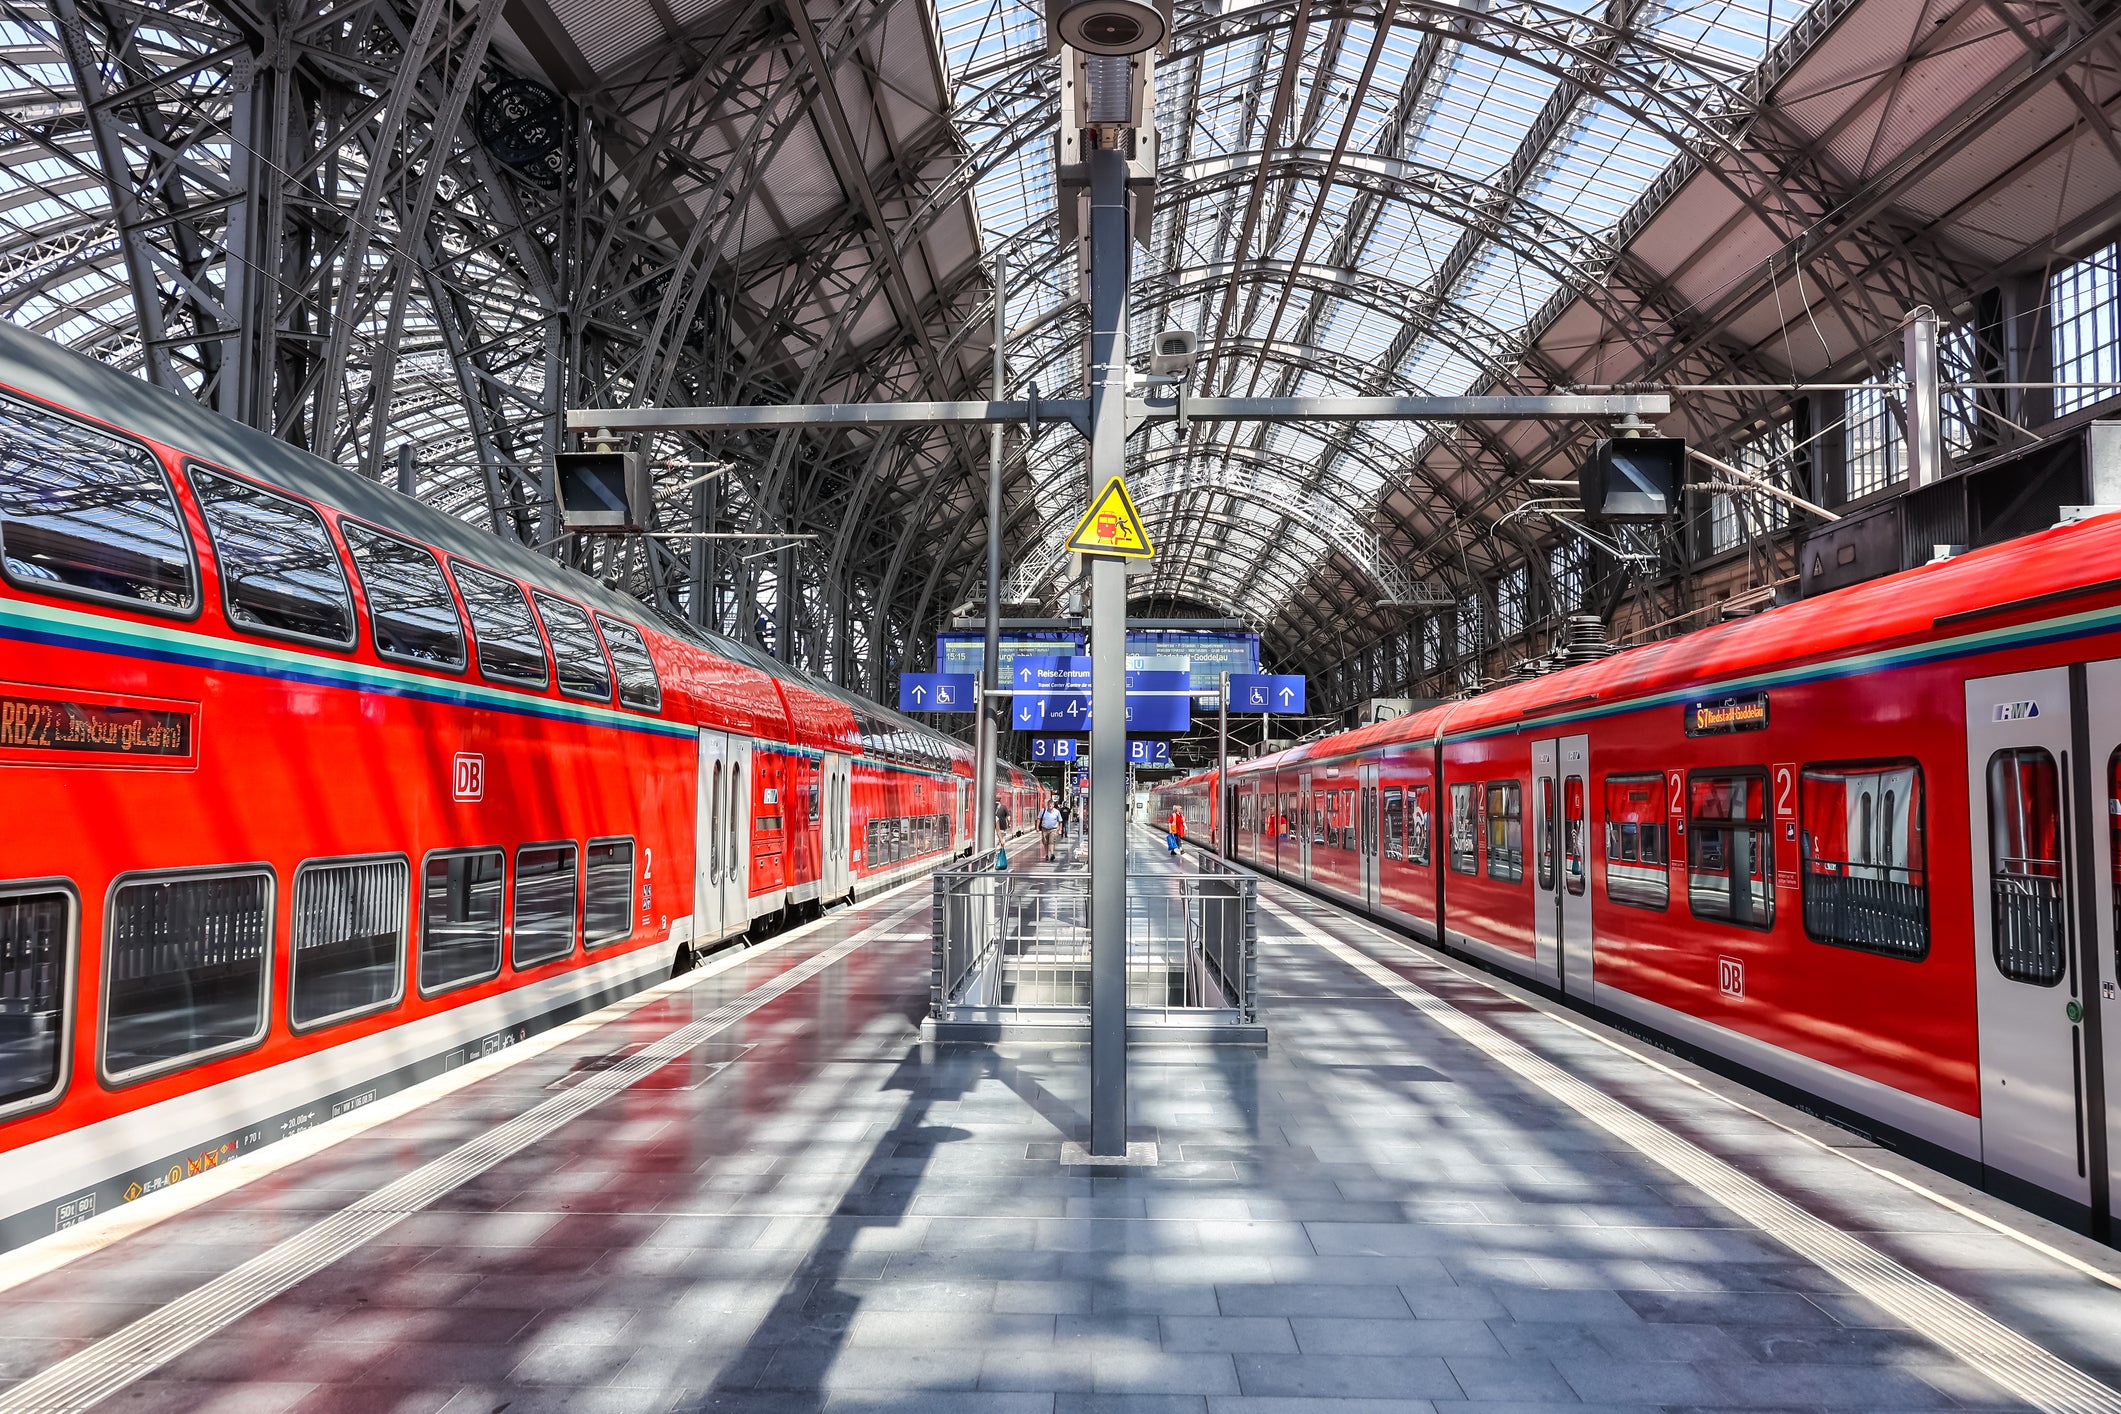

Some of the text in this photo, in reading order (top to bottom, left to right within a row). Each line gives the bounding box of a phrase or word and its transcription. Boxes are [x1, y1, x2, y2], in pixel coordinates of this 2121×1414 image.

[946, 652, 966, 661] 15:15
[1037, 669, 1091, 679] ReiseZentrum
[1037, 699, 1046, 718] 1
[1050, 710, 1064, 718] und
[1696, 708, 1708, 729] S7
[1997, 700, 2037, 721] RMV
[1, 701, 52, 746] RB22
[1035, 739, 1069, 757] 3 B
[1132, 741, 1167, 759] B 2
[456, 758, 482, 796] DB
[1072, 776, 1078, 785] 3
[1478, 783, 1484, 811] 2
[1670, 773, 1682, 813] 2
[1776, 768, 1793, 815] 2
[643, 847, 652, 880] 2
[1720, 960, 1743, 997] DB
[60, 1205, 75, 1220] 50t
